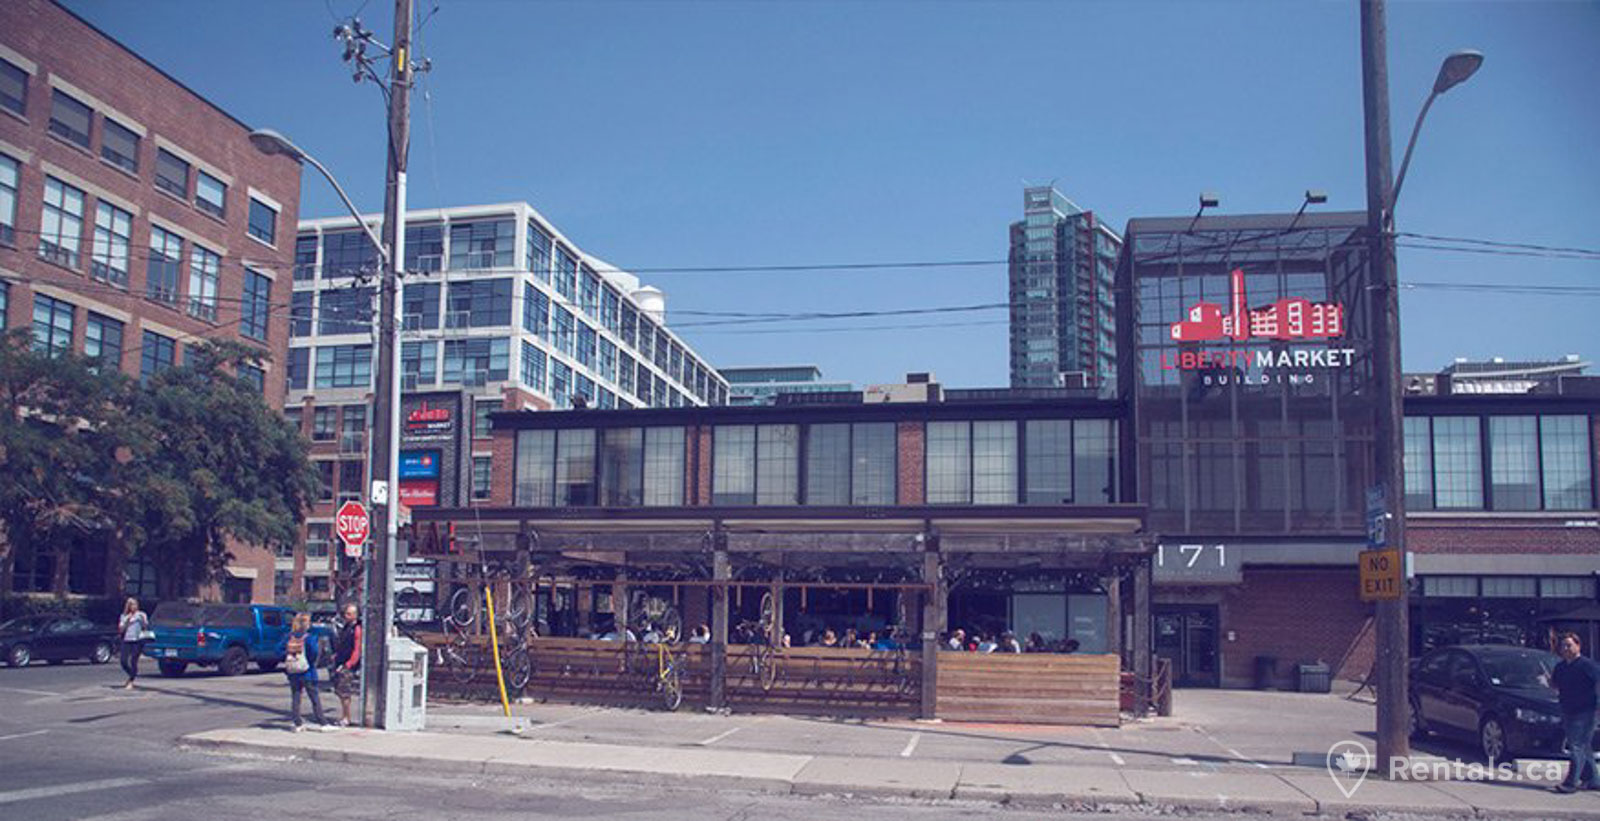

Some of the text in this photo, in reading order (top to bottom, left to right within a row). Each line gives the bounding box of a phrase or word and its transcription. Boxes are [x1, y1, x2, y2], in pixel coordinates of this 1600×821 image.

[1203, 374, 1314, 385] BUILDING
[339, 515, 367, 532] STOP
[1158, 544, 1225, 568] 171
[1369, 556, 1389, 572] NO
[1365, 578, 1393, 593] EXIT
